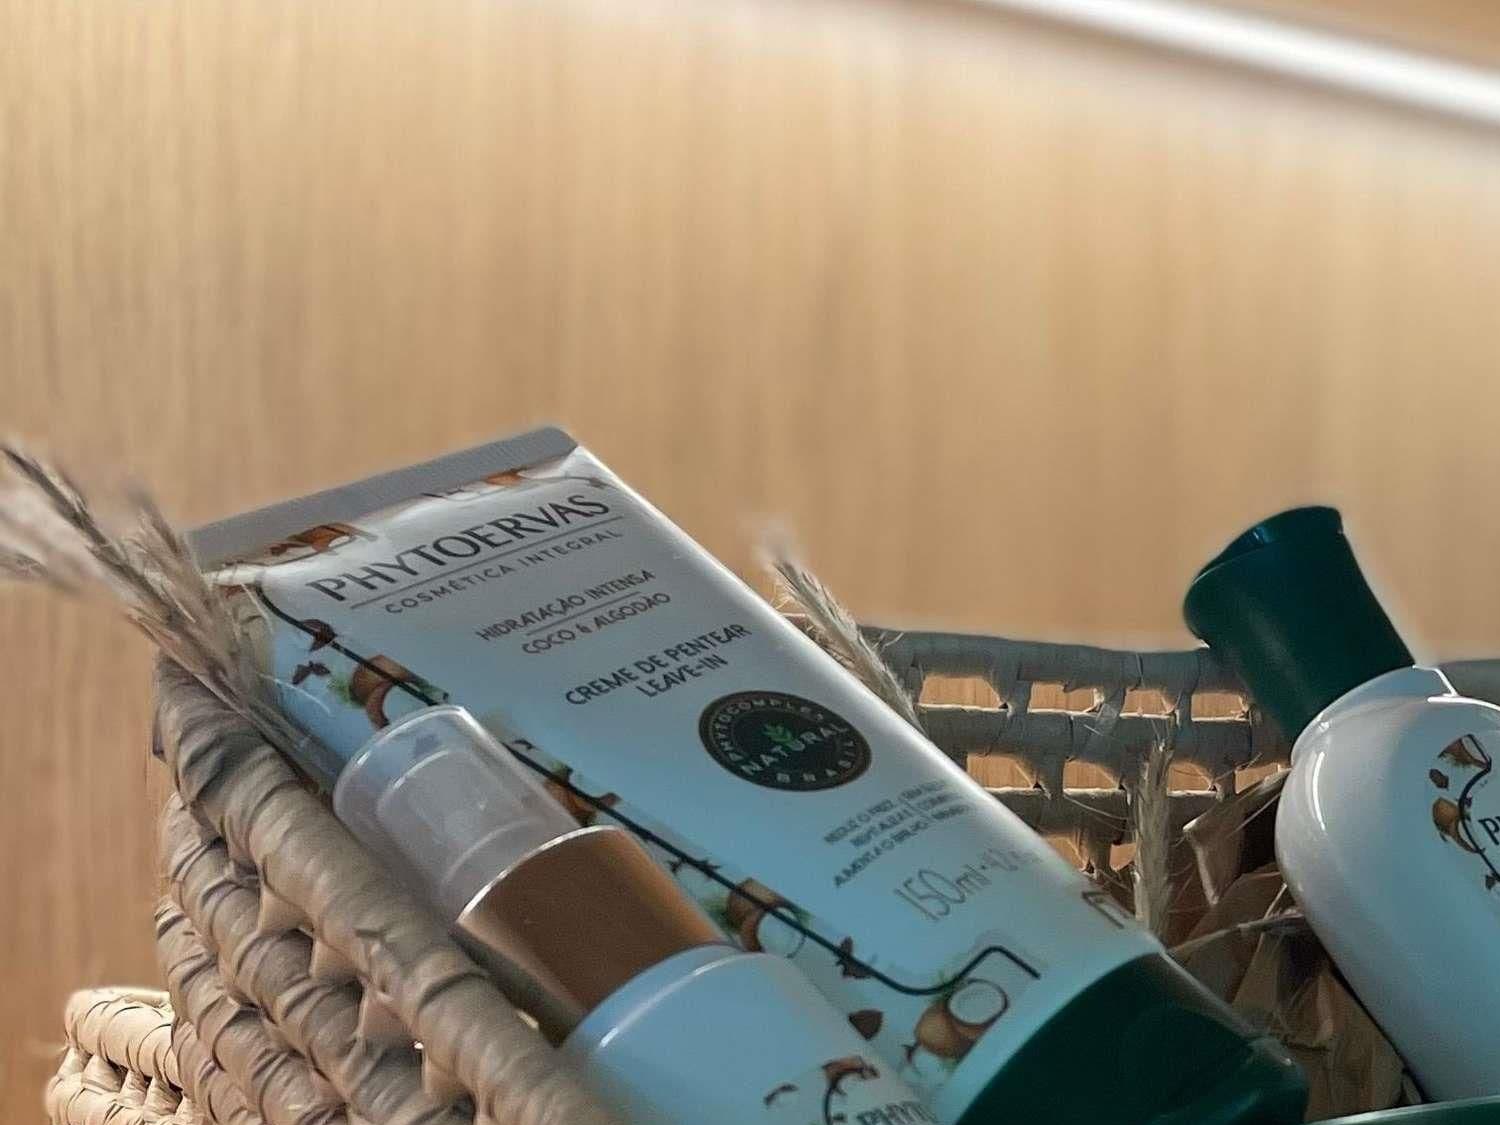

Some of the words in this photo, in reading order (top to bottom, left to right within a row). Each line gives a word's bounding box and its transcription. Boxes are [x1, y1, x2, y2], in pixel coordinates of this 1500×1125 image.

[306, 494, 610, 601] PHYTOERVAS
[385, 563, 515, 614] COSMÉTICA
[520, 529, 624, 568] INTEGRAL
[475, 594, 586, 641] HIDRATAÇÃO
[585, 569, 656, 600] INTENSA
[522, 629, 577, 654] COCO
[593, 591, 672, 630] ALGODÃO
[565, 666, 640, 705] CREME
[634, 654, 669, 675] DE
[663, 622, 753, 663] PENTEAR
[636, 653, 729, 698] LEAVE-IN
[740, 722, 848, 776] NATURAL
